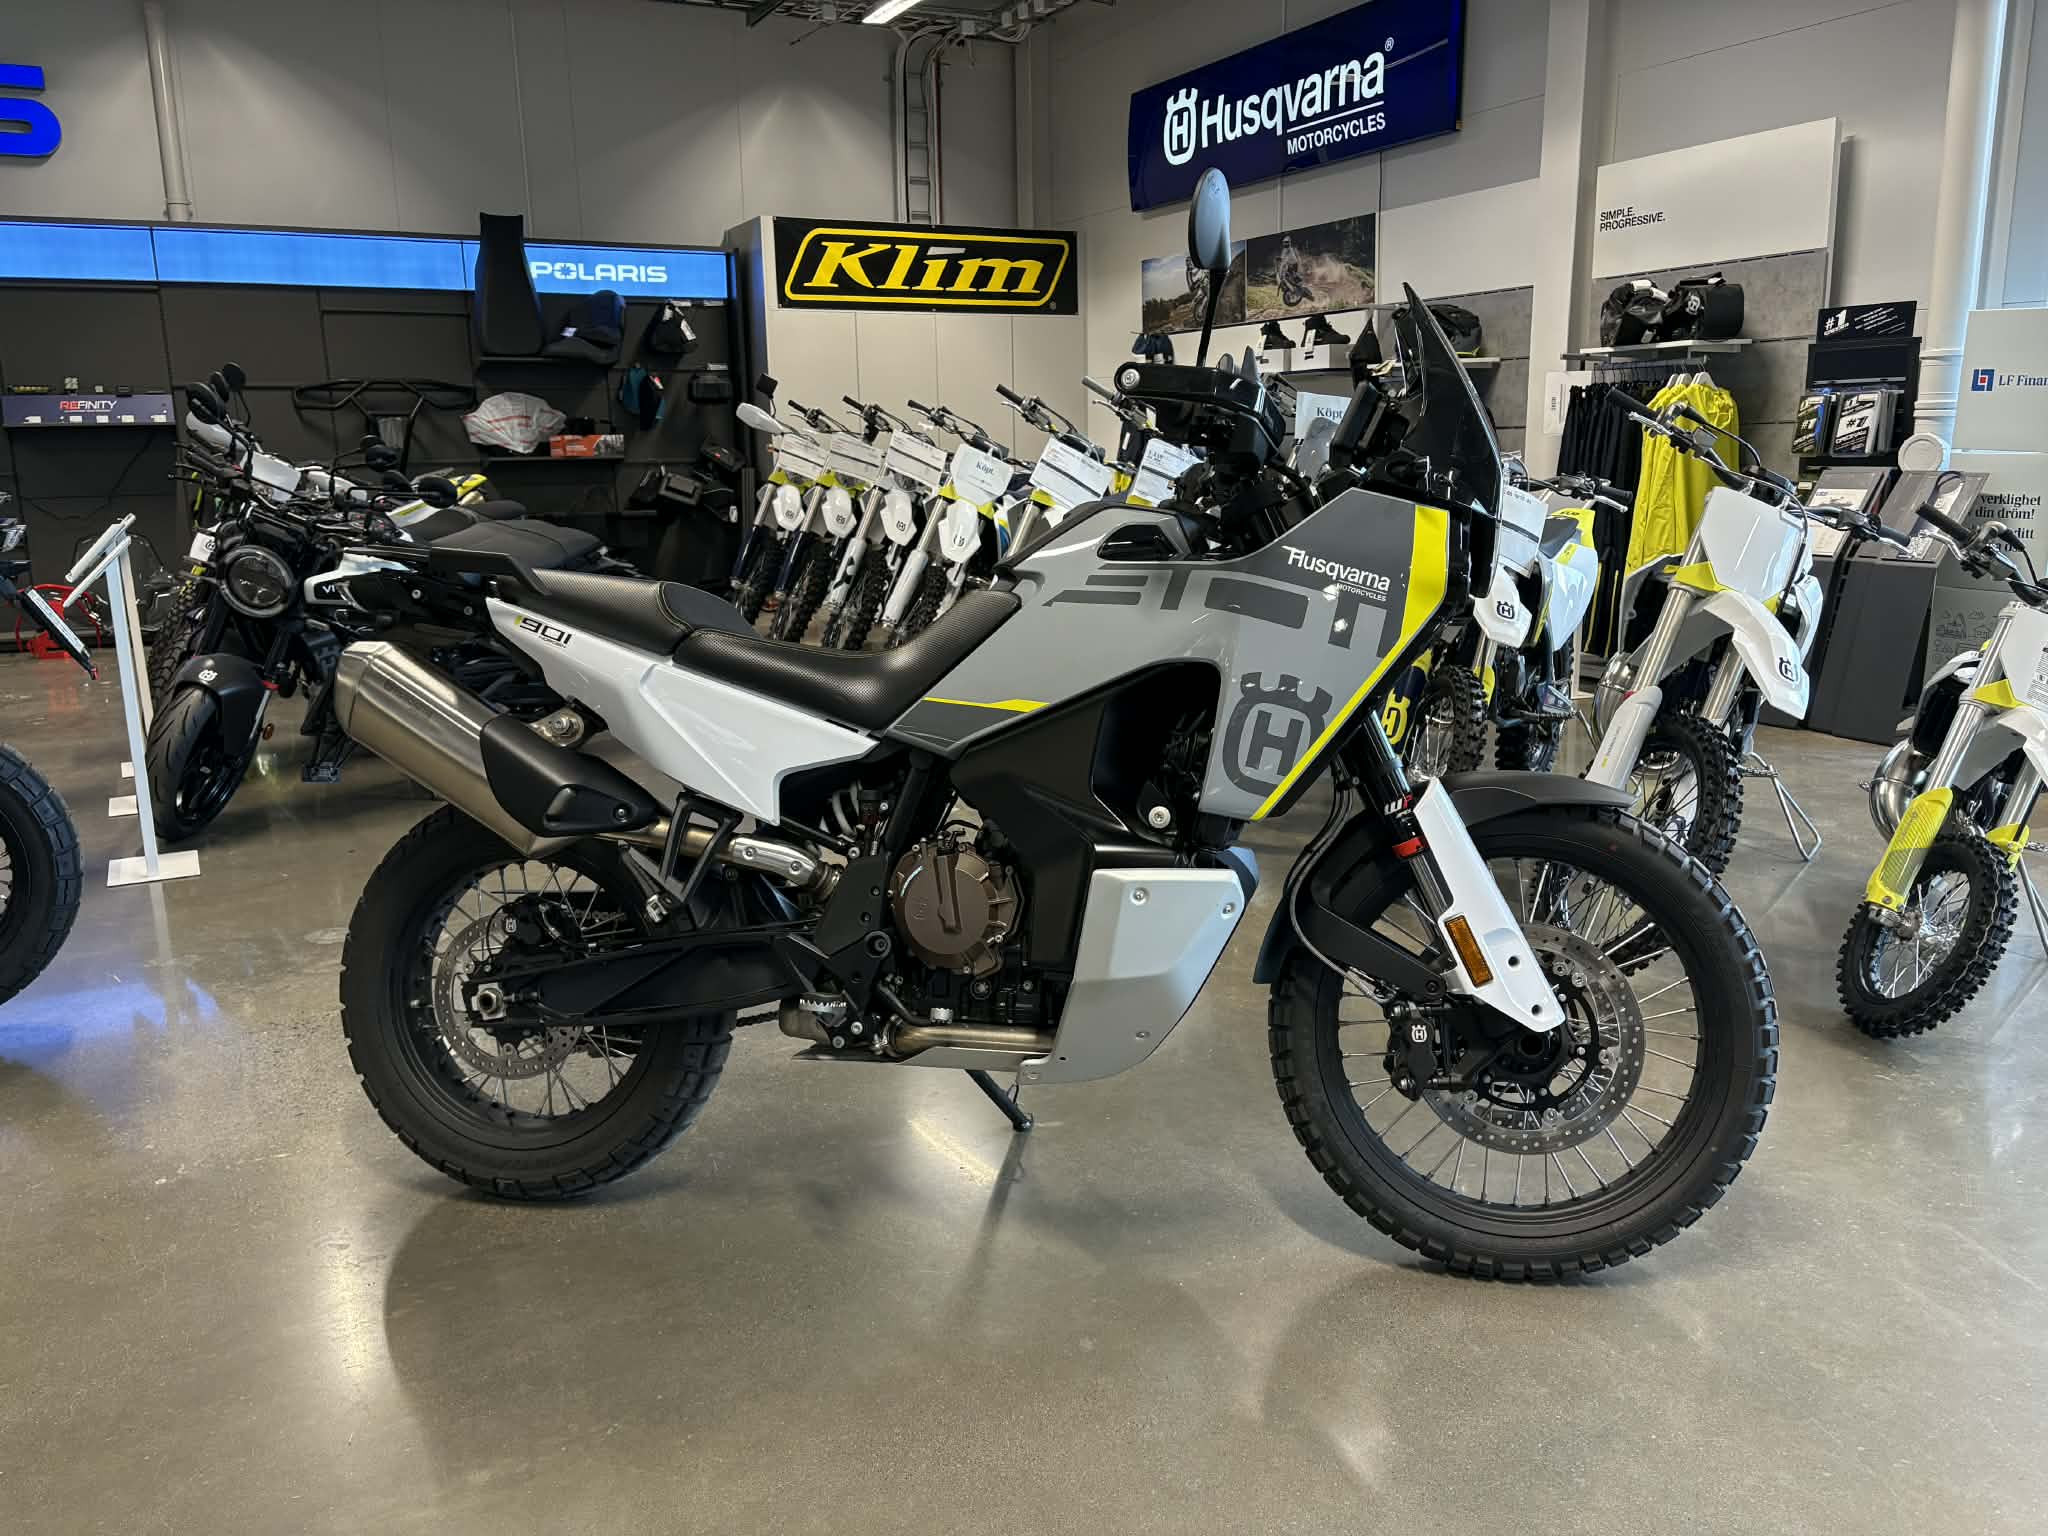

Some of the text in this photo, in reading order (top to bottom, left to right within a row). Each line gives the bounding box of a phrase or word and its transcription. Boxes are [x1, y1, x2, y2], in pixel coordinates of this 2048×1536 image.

[1287, 112, 1386, 155] MOTORCYCLES
[1600, 206, 1635, 222] SIMPLE.
[1600, 211, 1666, 232] PROGRESSIVE.
[529, 261, 668, 283] POLARIS
[1998, 374, 2015, 386] LF
[59, 400, 118, 411] REFINITY
[1980, 494, 2041, 507] verklighet
[1975, 507, 2035, 520] din dröm!
[1281, 545, 1391, 591] Husqvarna
[1336, 583, 1387, 601] MOTORCYCLES
[519, 617, 573, 645] 901
